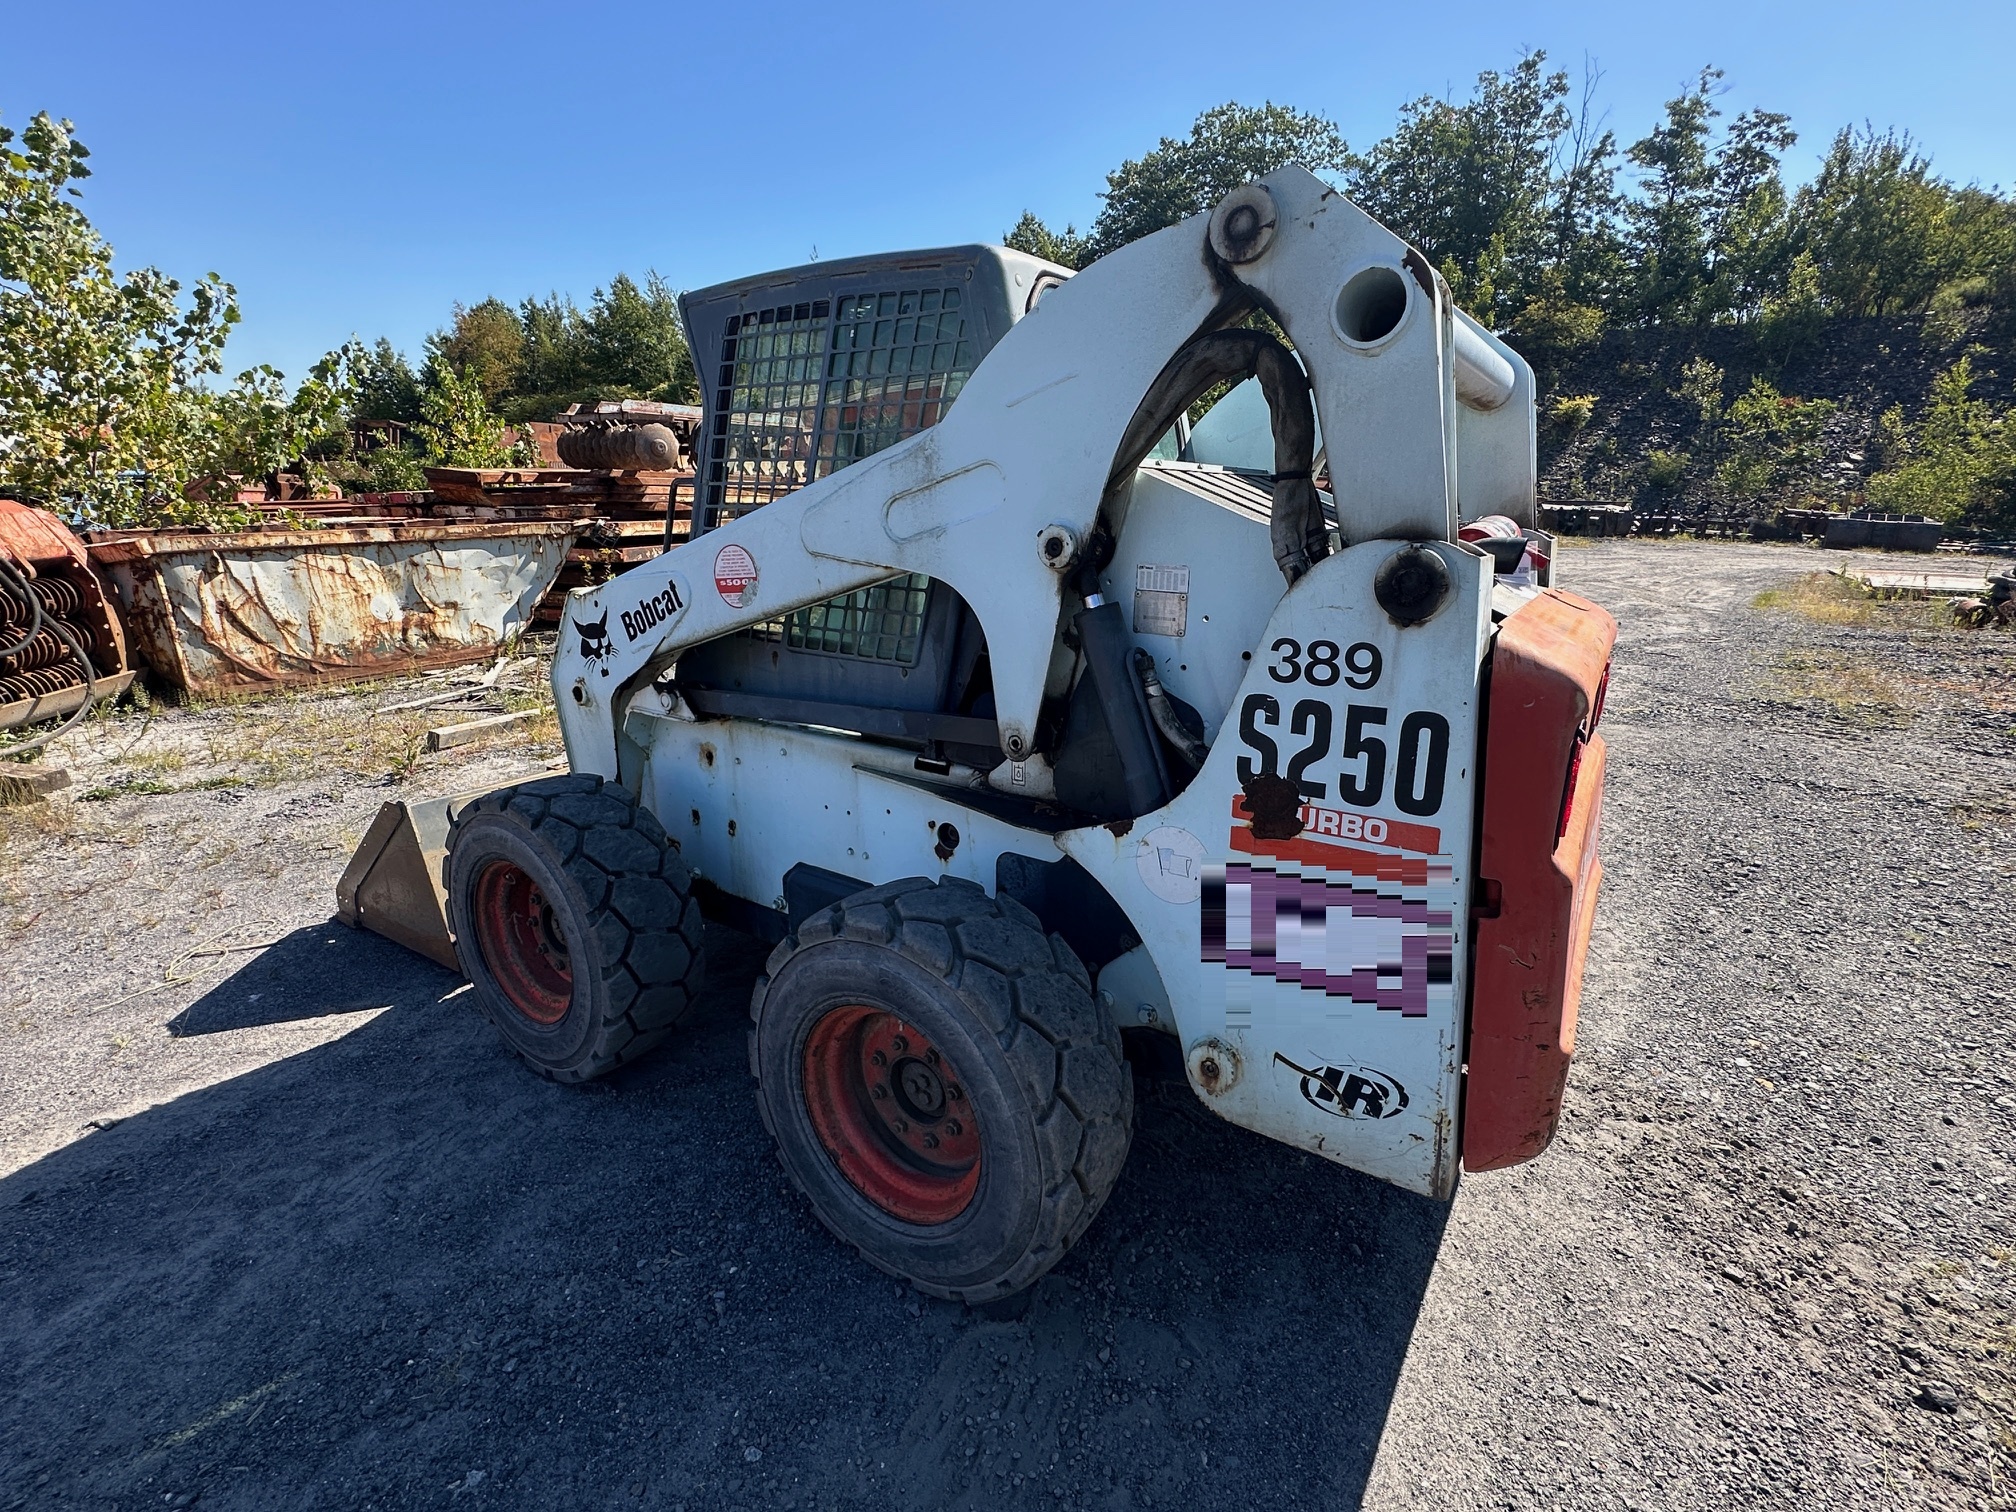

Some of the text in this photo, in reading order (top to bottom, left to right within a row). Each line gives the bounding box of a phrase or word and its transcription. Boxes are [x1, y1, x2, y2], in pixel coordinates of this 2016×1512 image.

[620, 579, 684, 643] Bobcat
[1267, 637, 1383, 690] 389
[1236, 693, 1450, 817] S250
[1296, 806, 1388, 843] URBO
